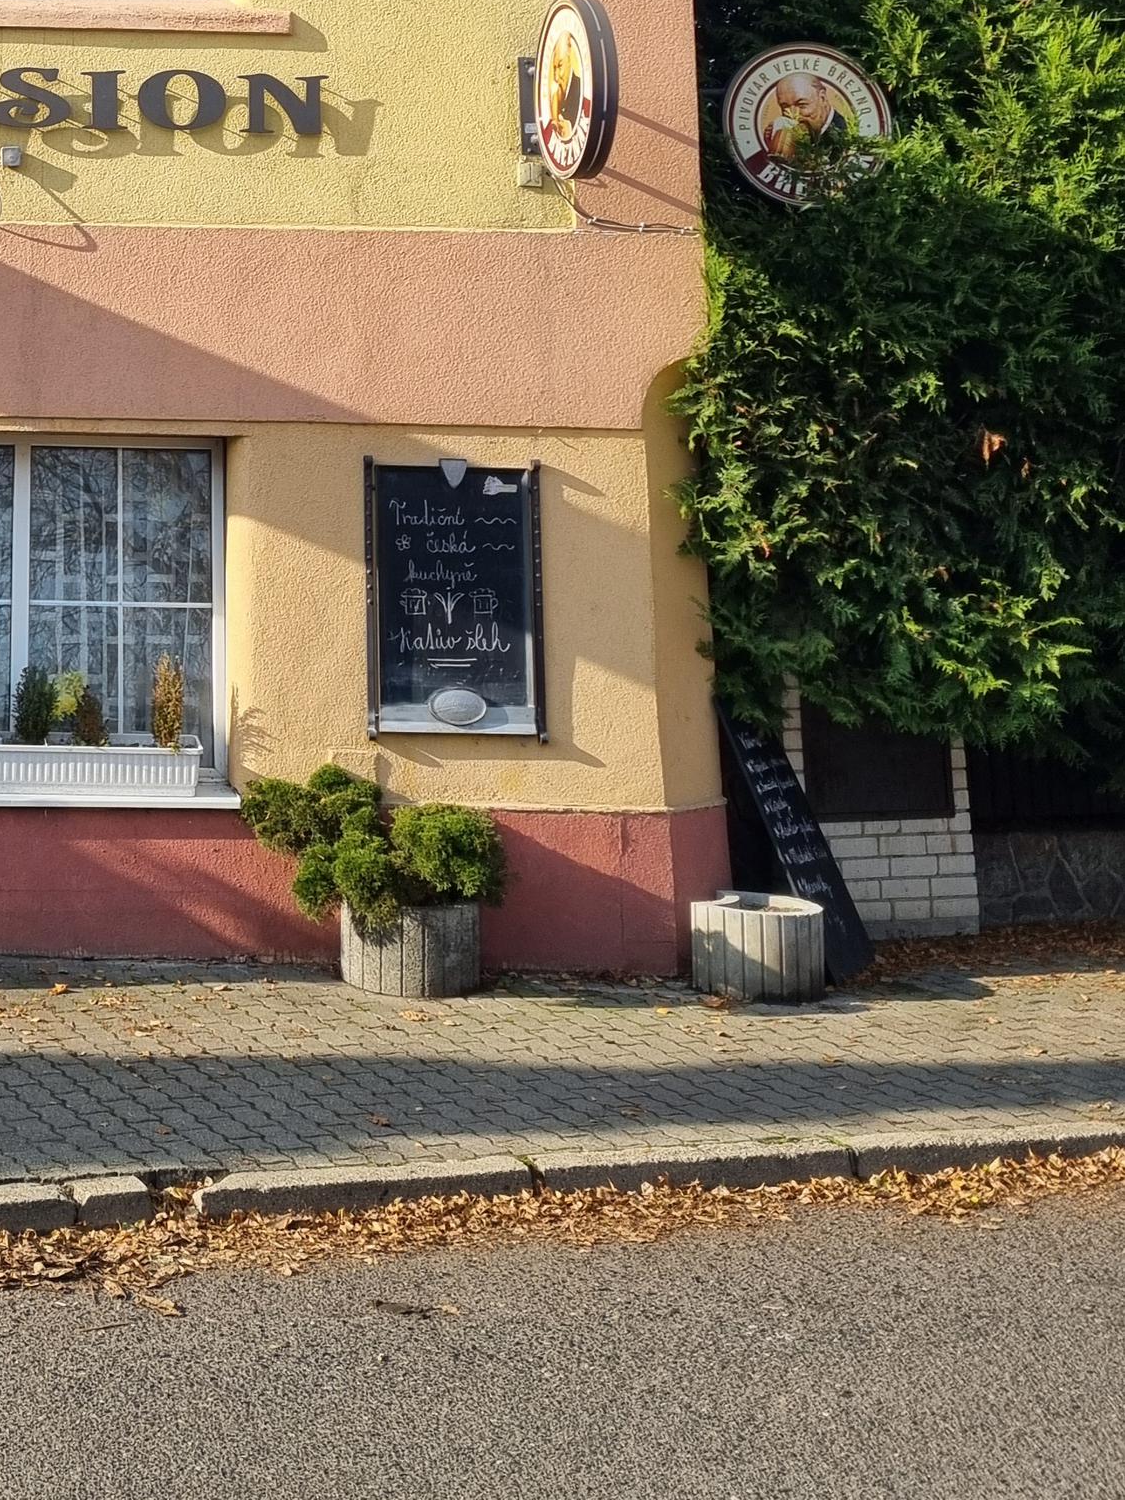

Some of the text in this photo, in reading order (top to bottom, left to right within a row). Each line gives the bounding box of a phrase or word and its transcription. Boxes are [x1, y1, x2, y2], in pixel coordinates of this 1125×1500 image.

[738, 57, 873, 132] PIVOVAR VELKÉ BŘEZNO
[388, 499, 465, 526] Tradiční
[426, 530, 476, 553] česká
[403, 558, 479, 589] kuchyně
